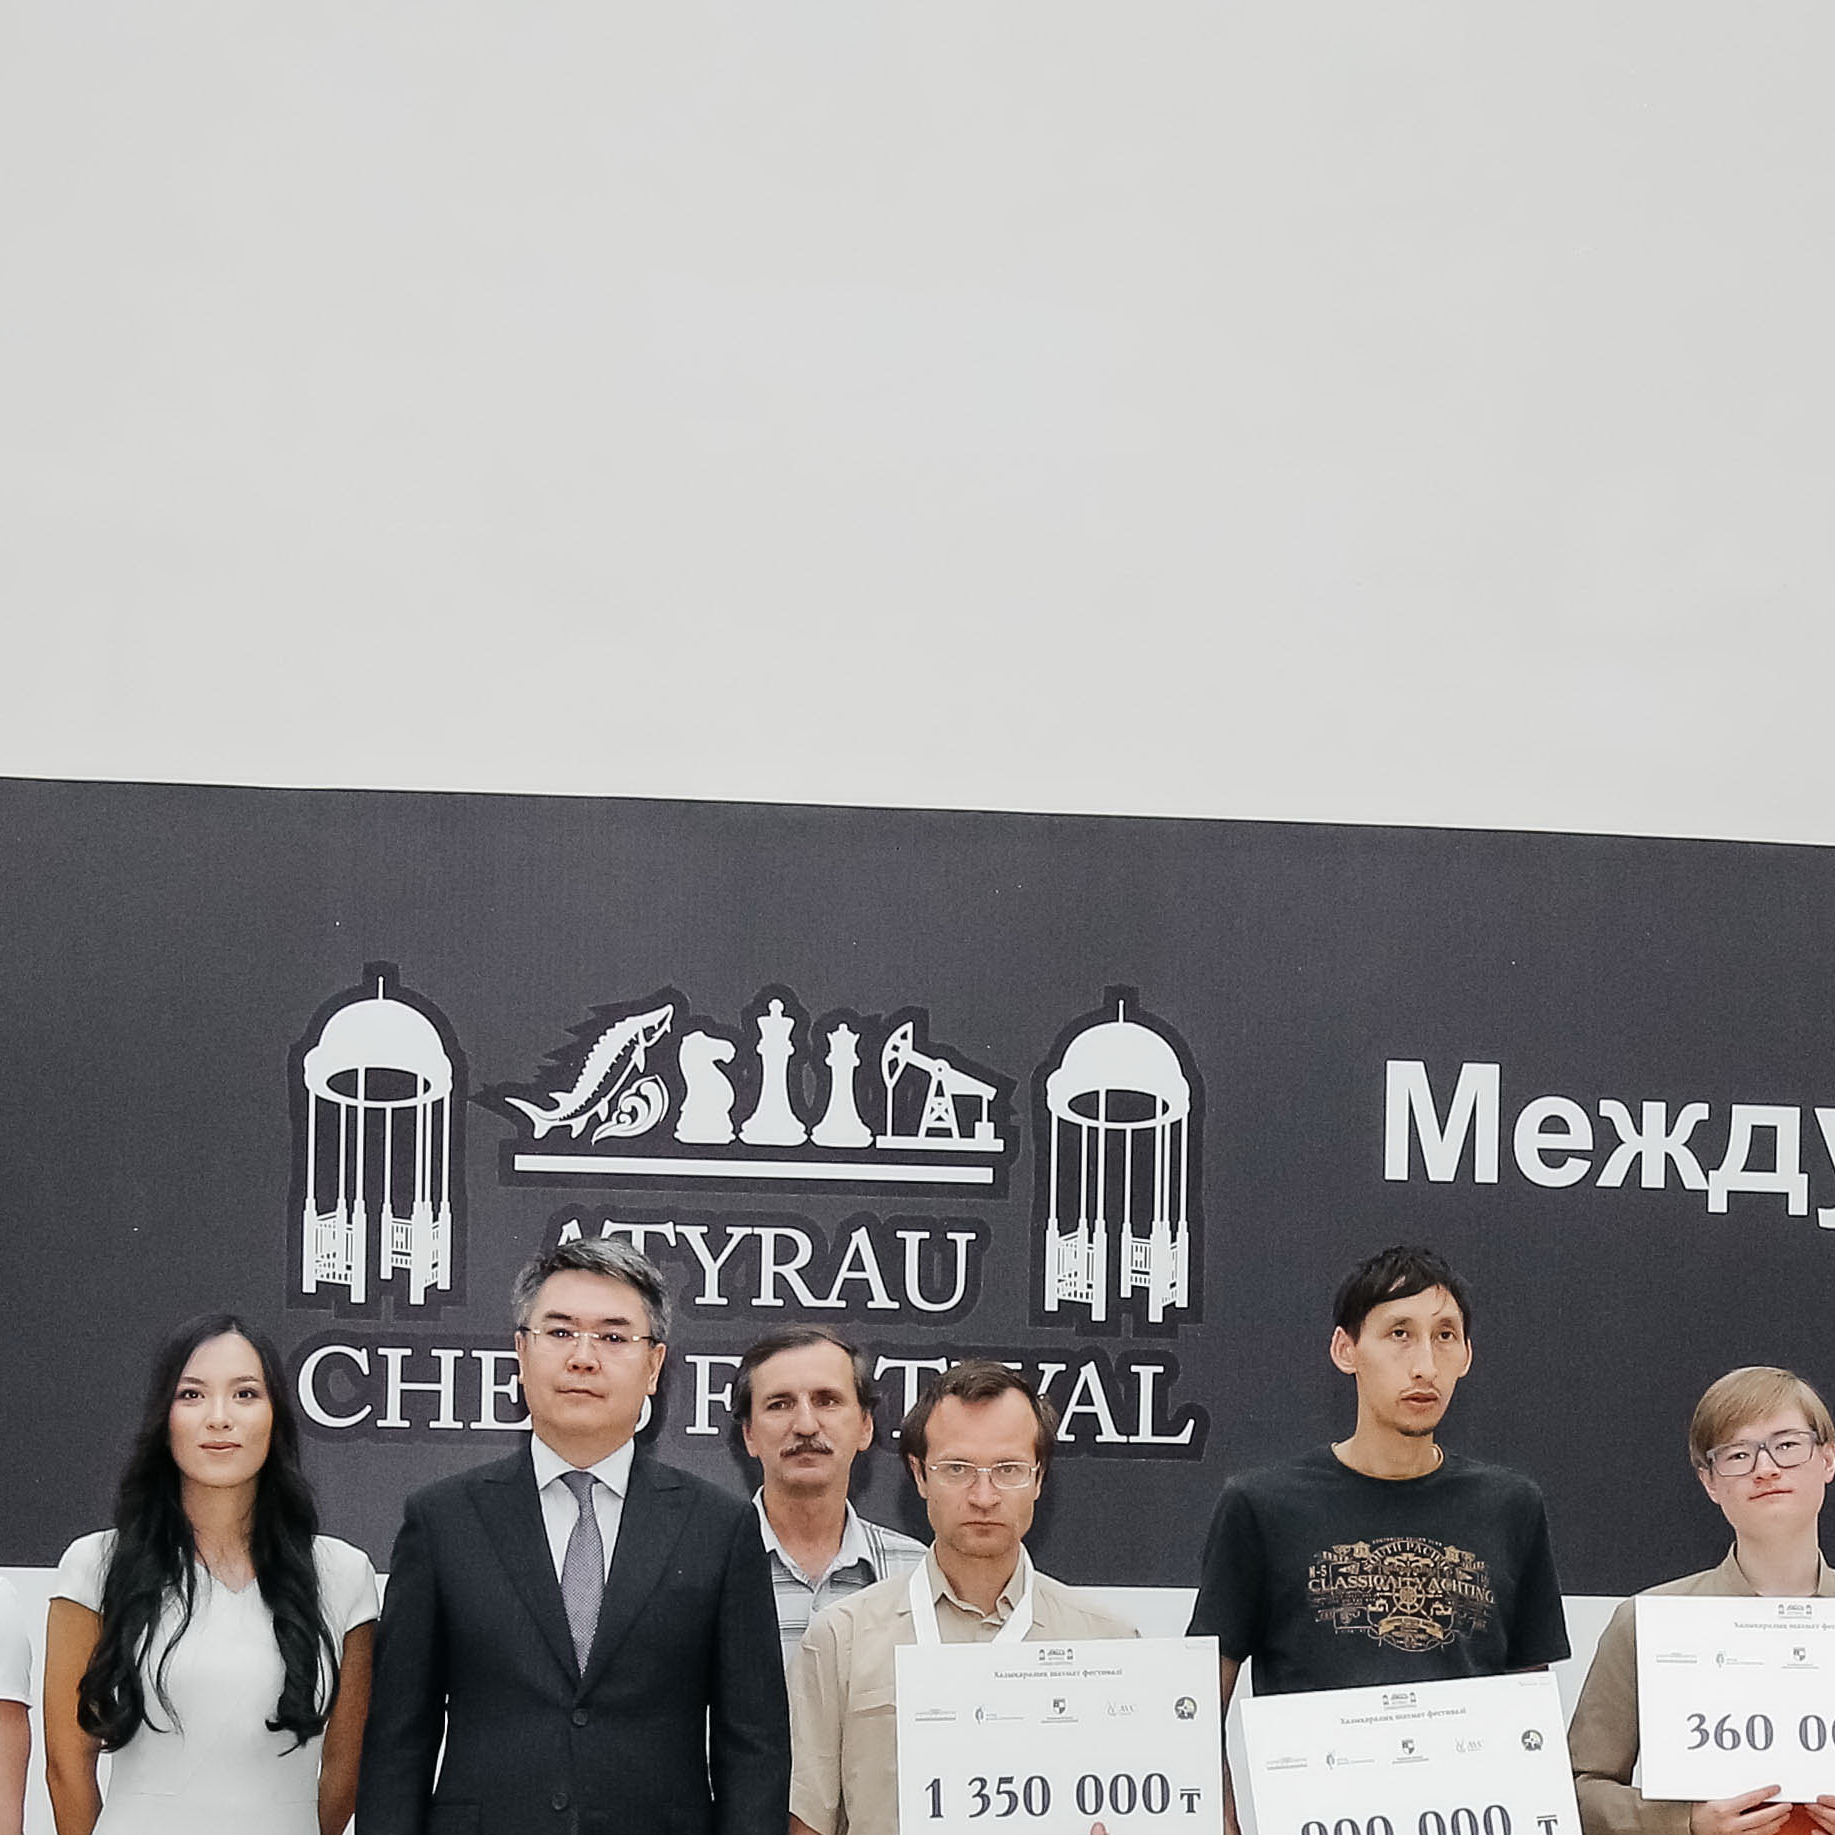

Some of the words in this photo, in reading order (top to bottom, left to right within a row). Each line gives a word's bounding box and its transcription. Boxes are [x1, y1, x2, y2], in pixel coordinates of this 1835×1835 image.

[1687, 1713, 1774, 1751] 360
[925, 1778, 944, 1819] 1
[968, 1775, 1051, 1818] 350
[1075, 1772, 1170, 1816] 000
